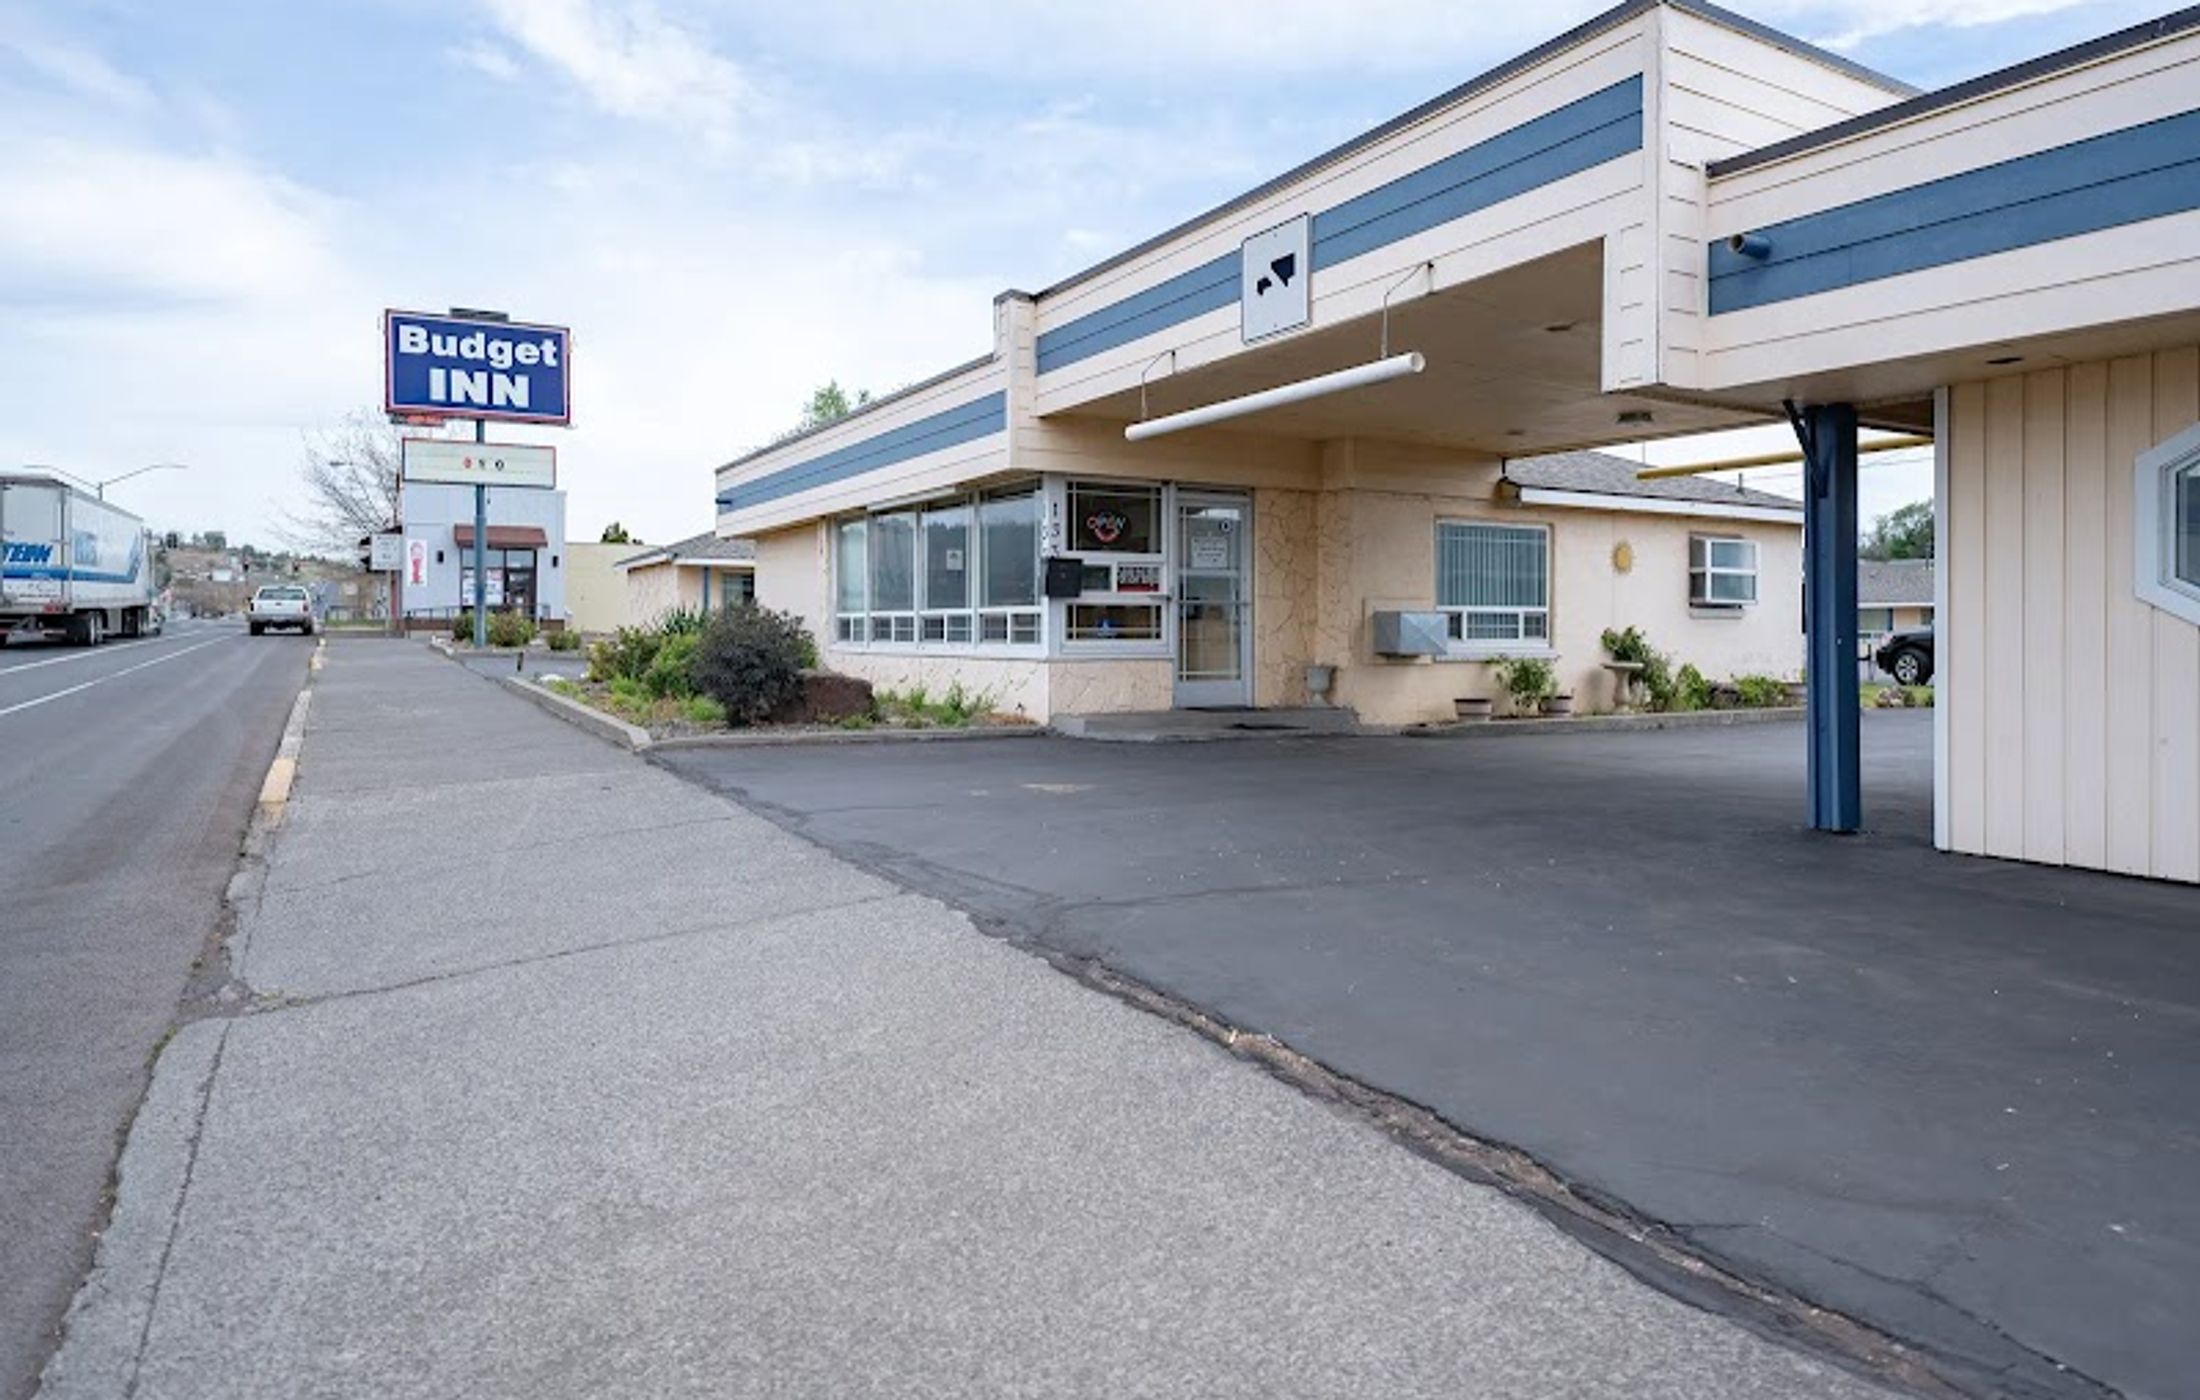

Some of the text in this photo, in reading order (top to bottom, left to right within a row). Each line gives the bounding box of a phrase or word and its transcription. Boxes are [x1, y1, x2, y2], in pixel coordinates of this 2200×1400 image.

[399, 324, 558, 368] Budget
[429, 368, 529, 408] INN
[1086, 511, 1127, 530] OPEN
